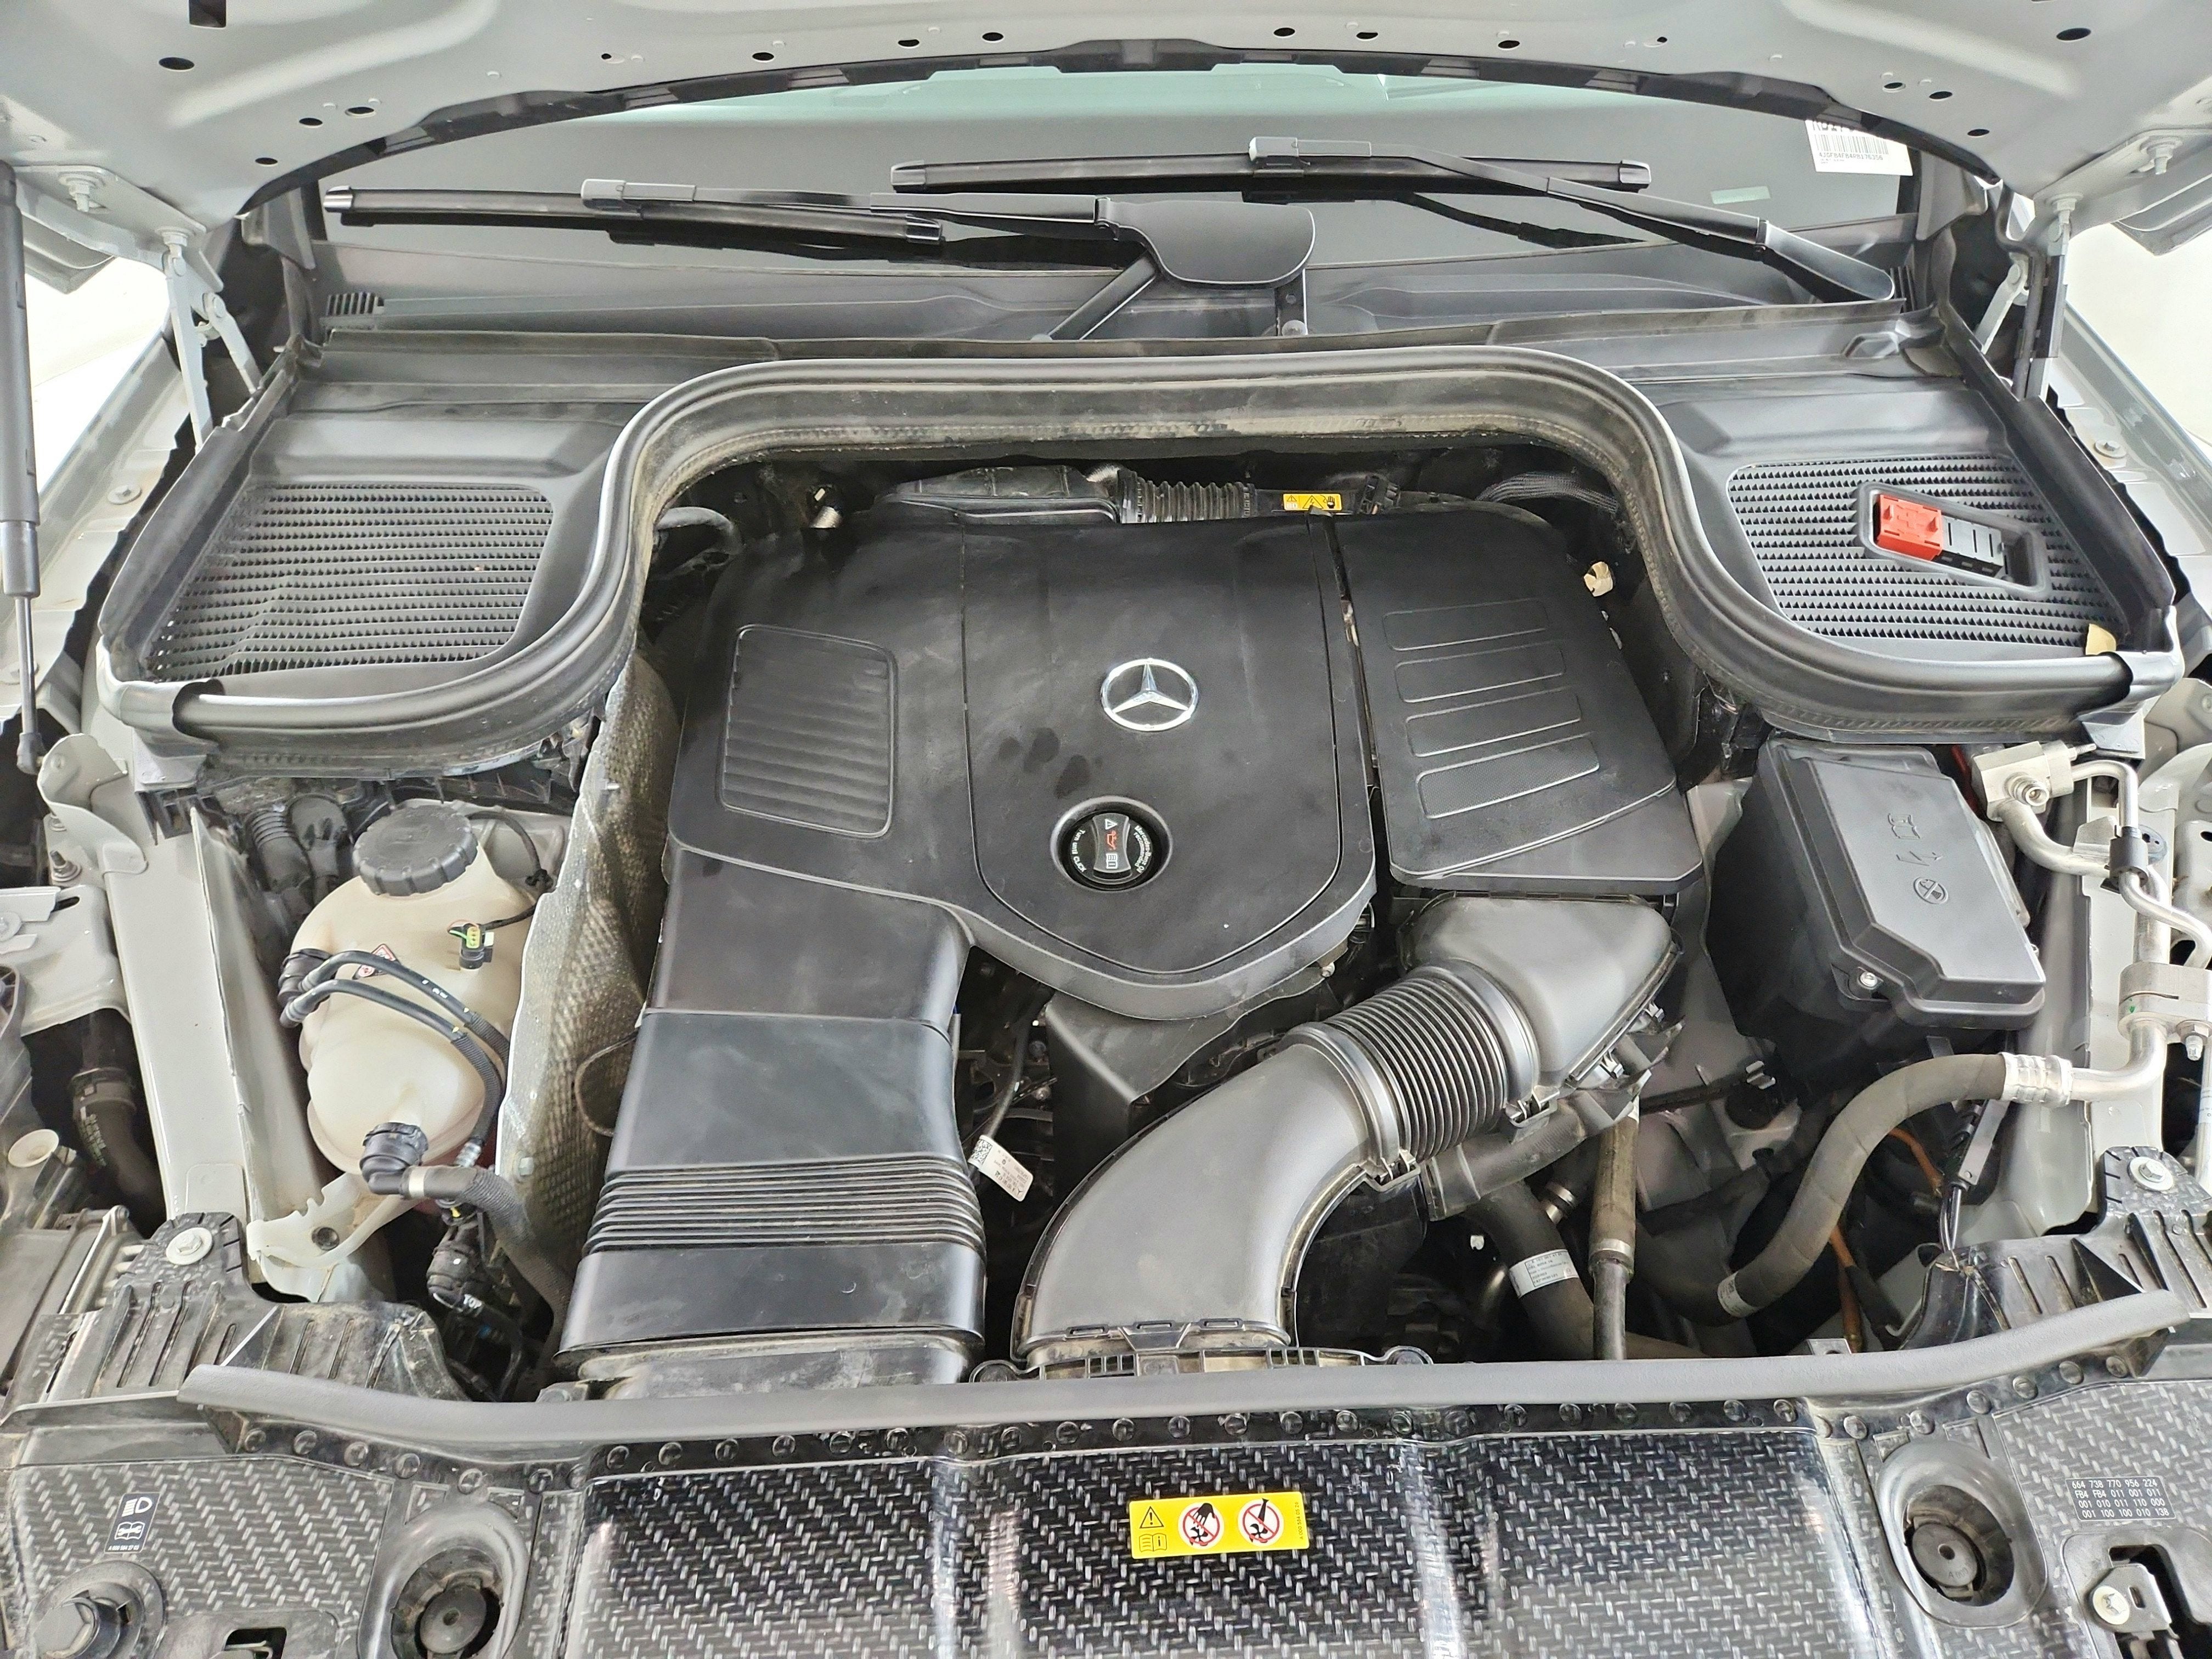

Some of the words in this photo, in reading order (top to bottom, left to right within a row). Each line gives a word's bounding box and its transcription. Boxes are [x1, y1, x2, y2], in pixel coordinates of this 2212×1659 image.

[1135, 825, 1151, 866] Mercedes-Benz
[1073, 856, 1087, 872] CLICK
[1136, 865, 1144, 873] Oil
[464, 1294, 482, 1309] TOP
[2072, 1481, 2085, 1489] 664
